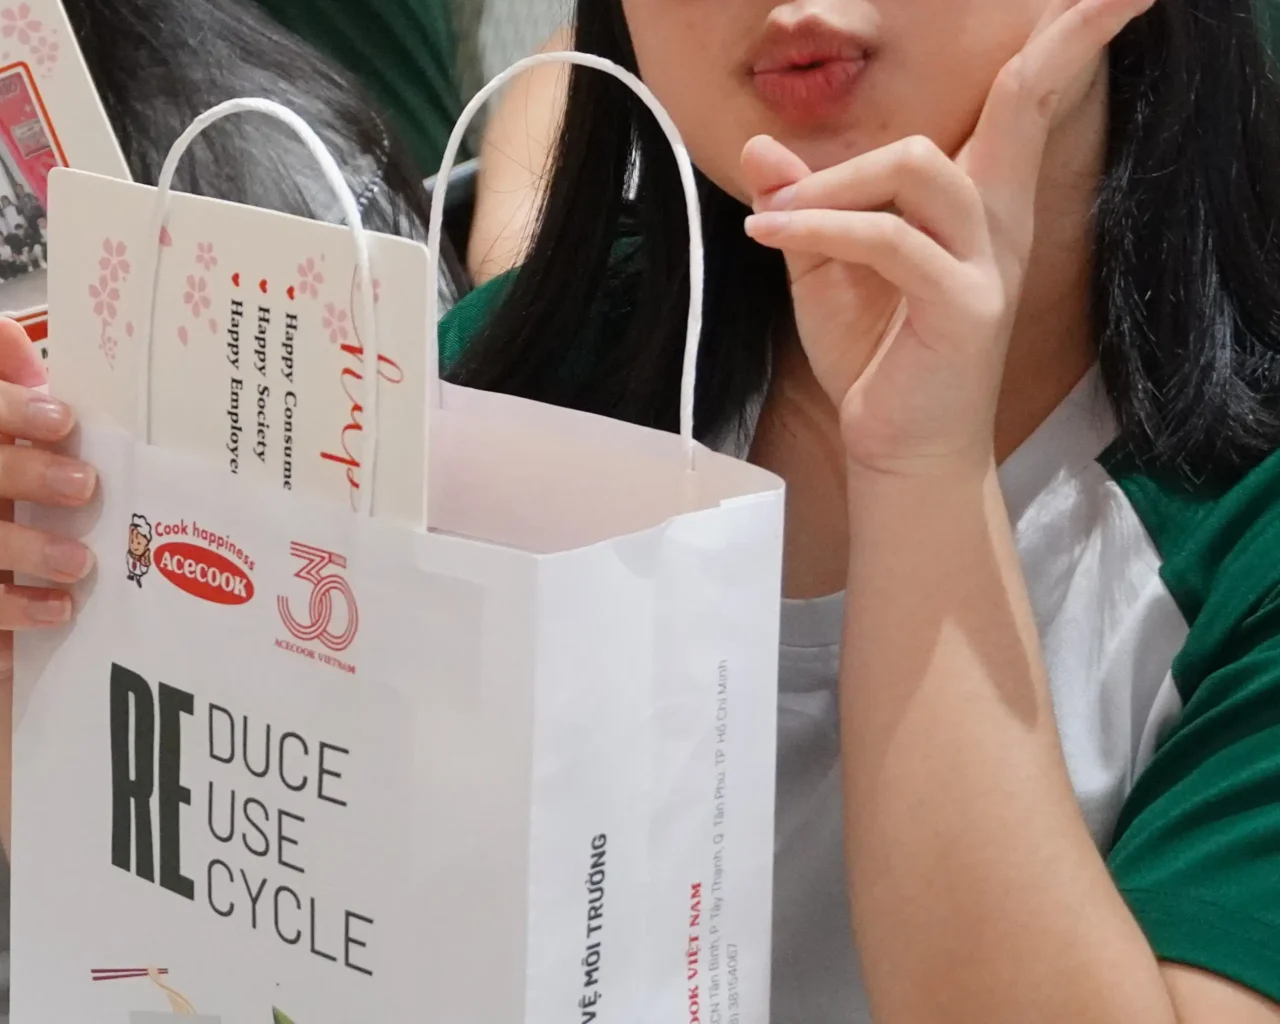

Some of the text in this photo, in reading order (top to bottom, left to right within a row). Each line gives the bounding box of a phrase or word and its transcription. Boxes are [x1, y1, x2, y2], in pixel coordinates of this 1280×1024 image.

[226, 298, 243, 370] Happy
[281, 313, 298, 384] Happy
[253, 305, 270, 463] Happy Society
[154, 519, 256, 571] Cook happiness
[277, 540, 359, 652] 30
[274, 638, 357, 675] ACECOOK VIETNAM
[110, 661, 195, 902] RE
[208, 702, 350, 807] DUCE
[208, 780, 306, 873] USE
[208, 858, 375, 977] CYCLE
[585, 833, 607, 939] TRƯỜNG
[688, 882, 702, 927] NAM
[581, 941, 601, 988] MÔI
[684, 934, 701, 981] VIỆT
